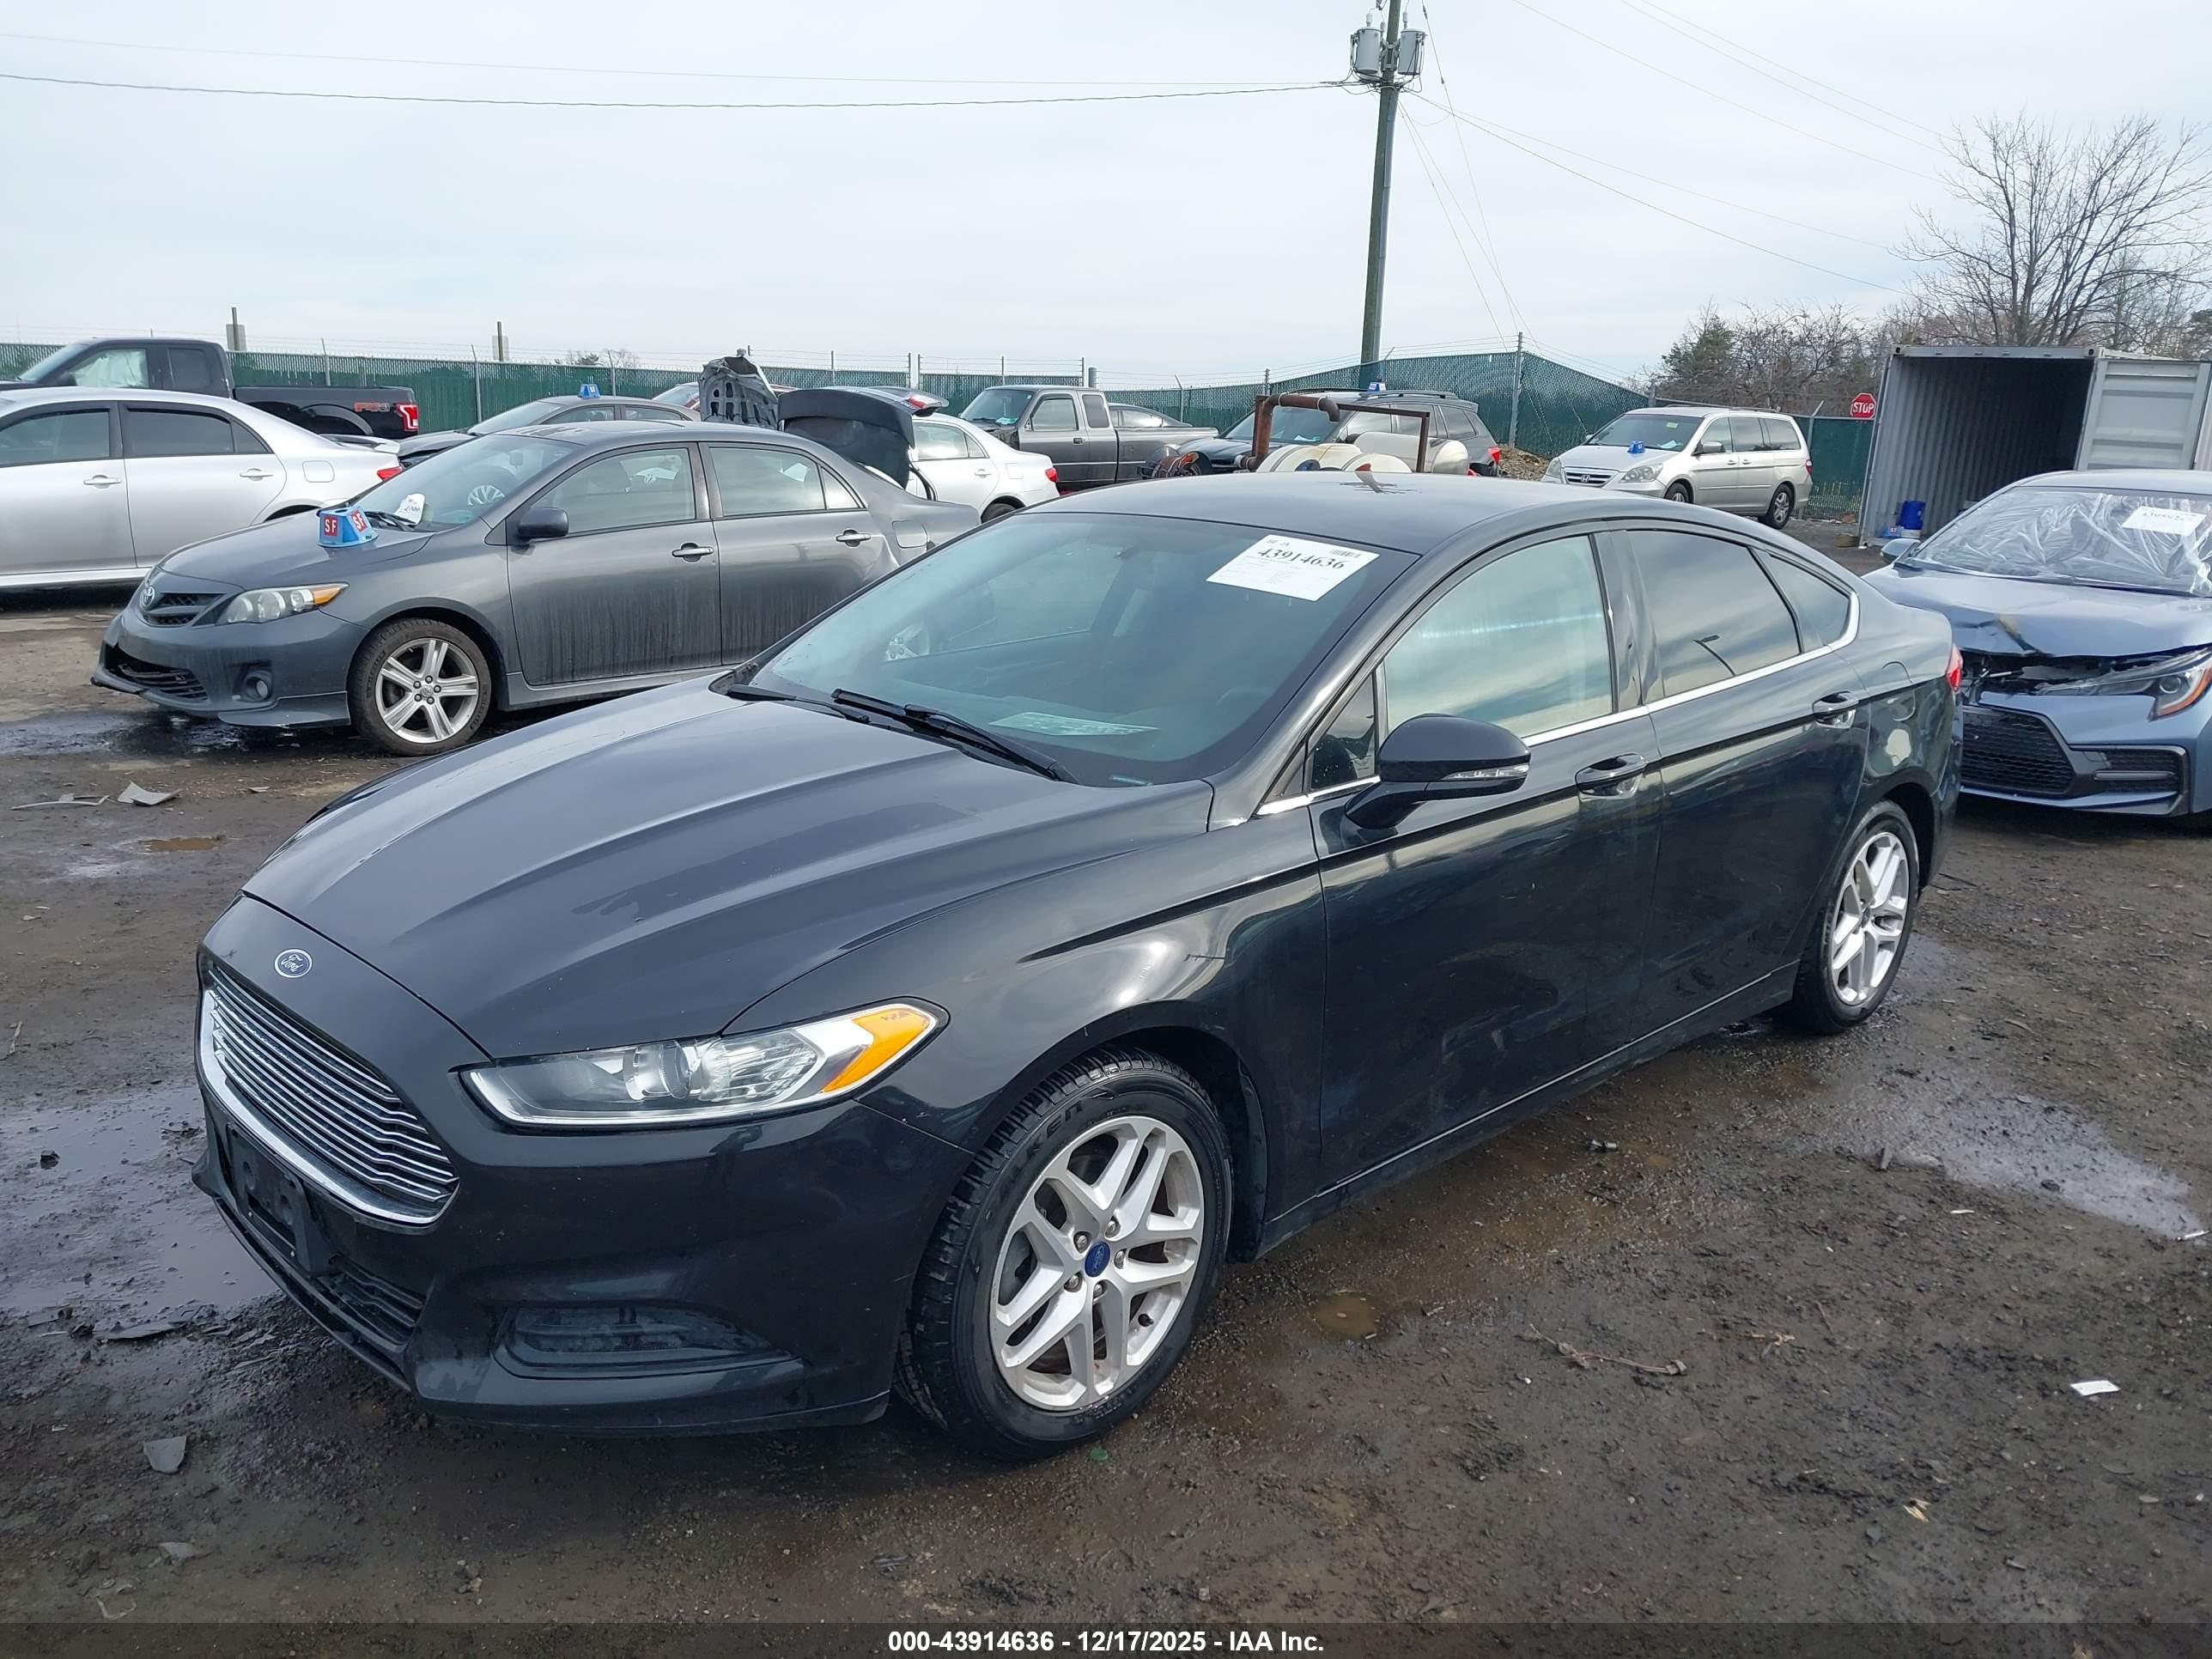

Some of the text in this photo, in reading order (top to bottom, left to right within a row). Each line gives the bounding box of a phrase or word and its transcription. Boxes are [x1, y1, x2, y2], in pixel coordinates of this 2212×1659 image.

[1852, 402, 1875, 414] STOP
[325, 519, 337, 533] SF
[353, 513, 365, 531] SF
[1256, 547, 1346, 570] 43914636
[280, 953, 305, 973] Ford
